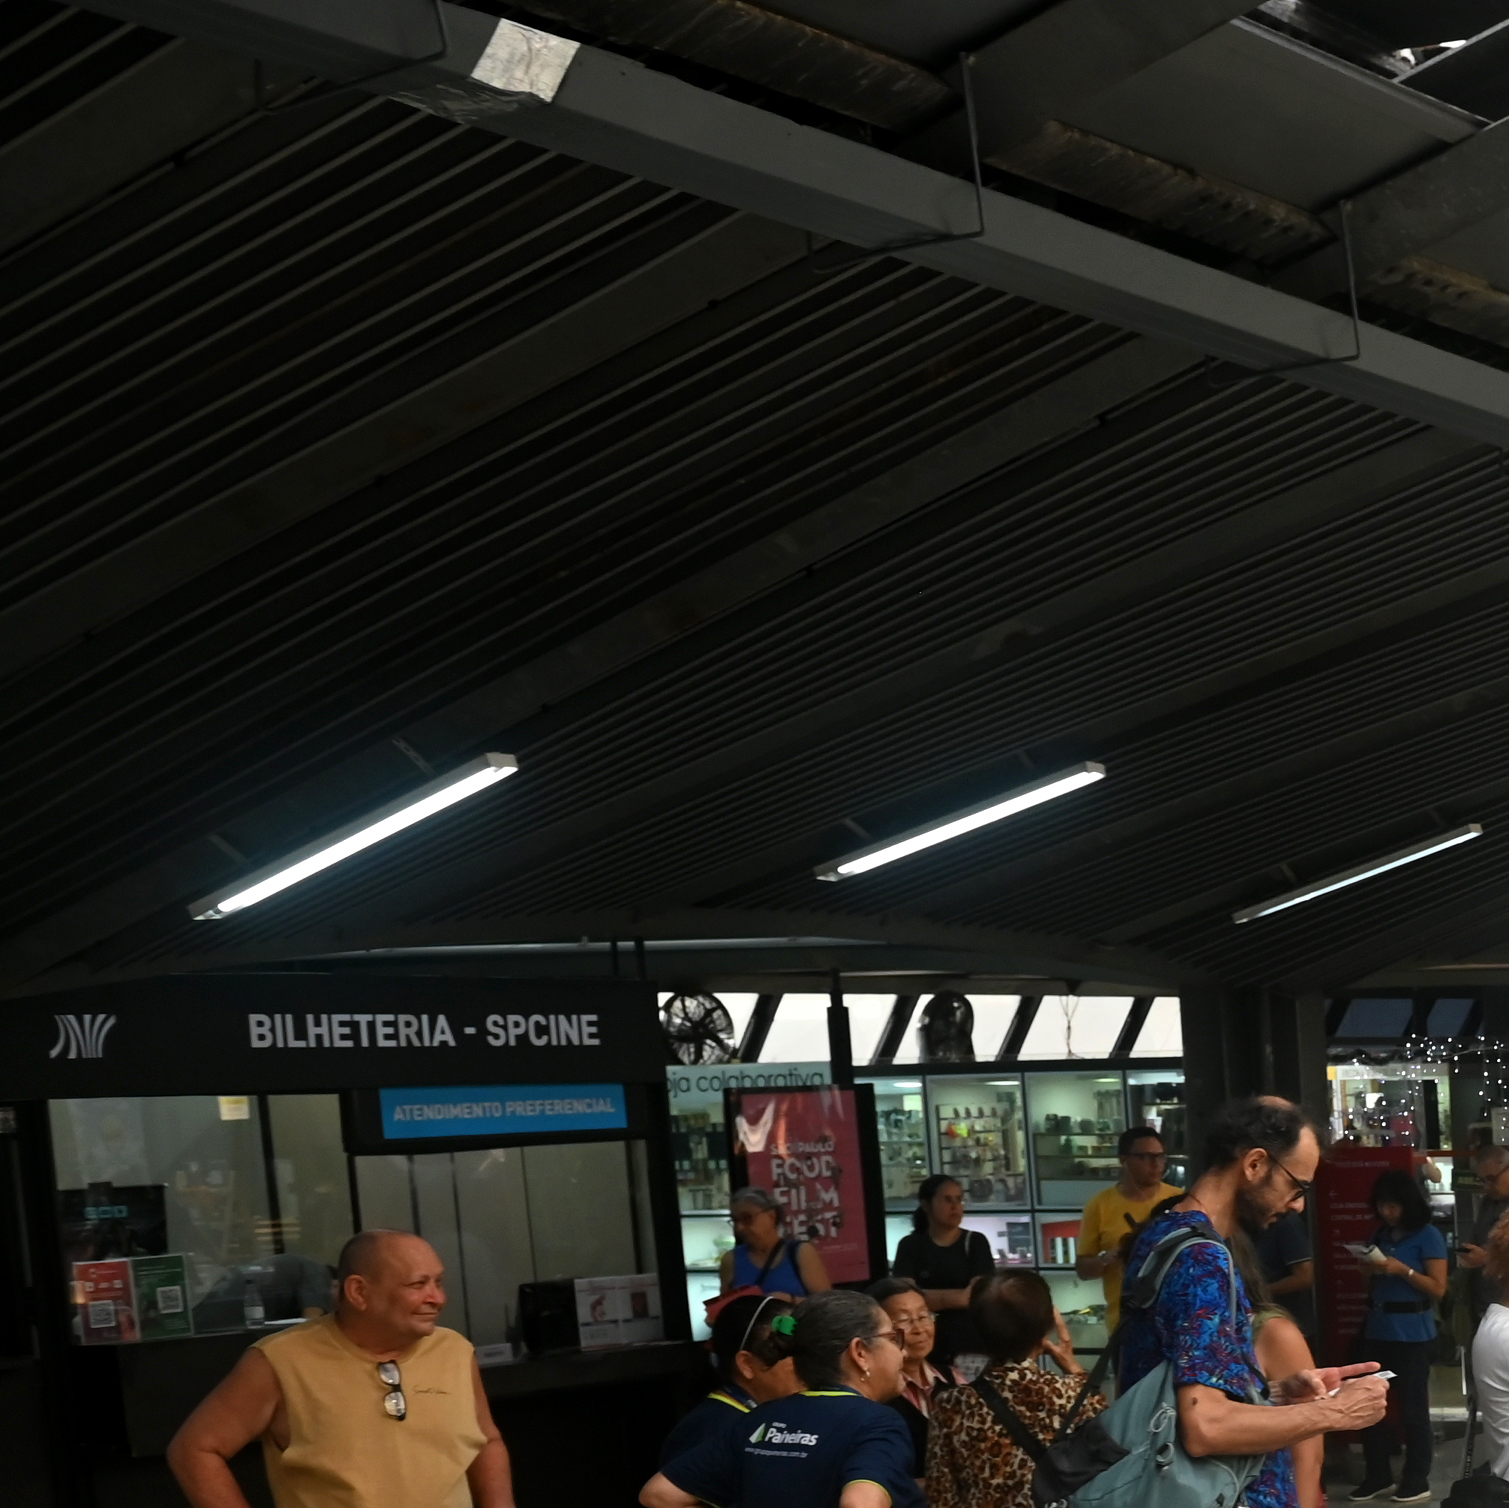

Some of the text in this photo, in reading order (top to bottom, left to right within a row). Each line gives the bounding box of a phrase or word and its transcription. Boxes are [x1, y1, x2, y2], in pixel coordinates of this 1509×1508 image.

[248, 1013, 456, 1048] BILHETERIA
[486, 1014, 600, 1046] SPCINE
[667, 1067, 824, 1098] oja colaborativa
[393, 1098, 616, 1121] ATENDIMENTO PREFERENCIAL
[771, 1156, 838, 1181] FOOD
[764, 1427, 819, 1446] Paineiras
